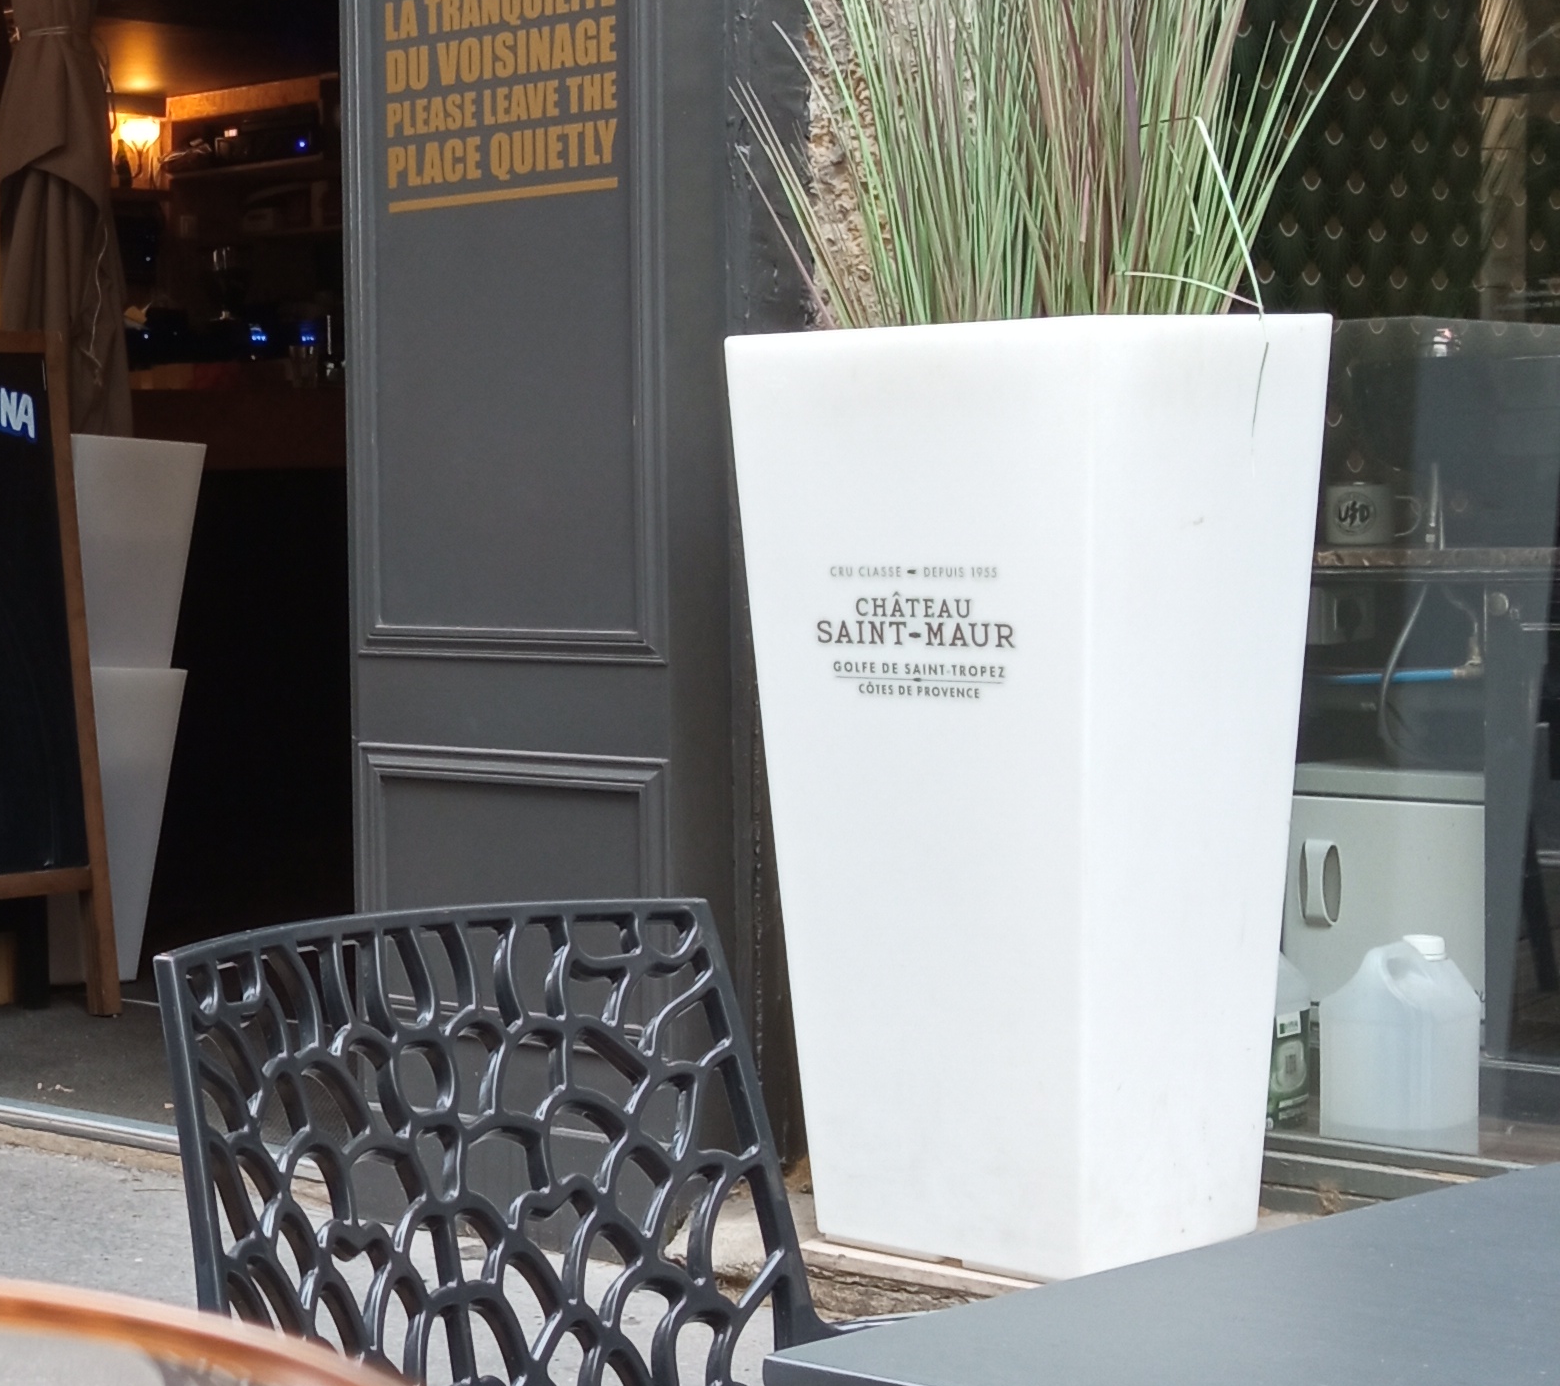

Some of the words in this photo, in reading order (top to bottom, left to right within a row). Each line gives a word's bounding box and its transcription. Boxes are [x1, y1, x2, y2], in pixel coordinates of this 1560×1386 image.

[386, 45, 429, 94] DU
[436, 15, 617, 87] VOISINAGE
[386, 91, 477, 138] PLEASE
[483, 79, 559, 126] LEAVE
[565, 71, 617, 114] THE
[388, 136, 482, 189] PLACE
[489, 118, 618, 181] QUIETLY
[830, 566, 853, 578] CRU
[923, 567, 965, 578] DEPUIS
[971, 567, 998, 579] 1955
[855, 591, 973, 619] CHÂTEAU
[817, 620, 1016, 649] SAINT-MAUR
[833, 661, 876, 674] GOLFE
[882, 662, 899, 675] DE
[858, 681, 894, 695] CÔTES
[898, 684, 913, 696] DE
[917, 686, 981, 699] PROVENCE
